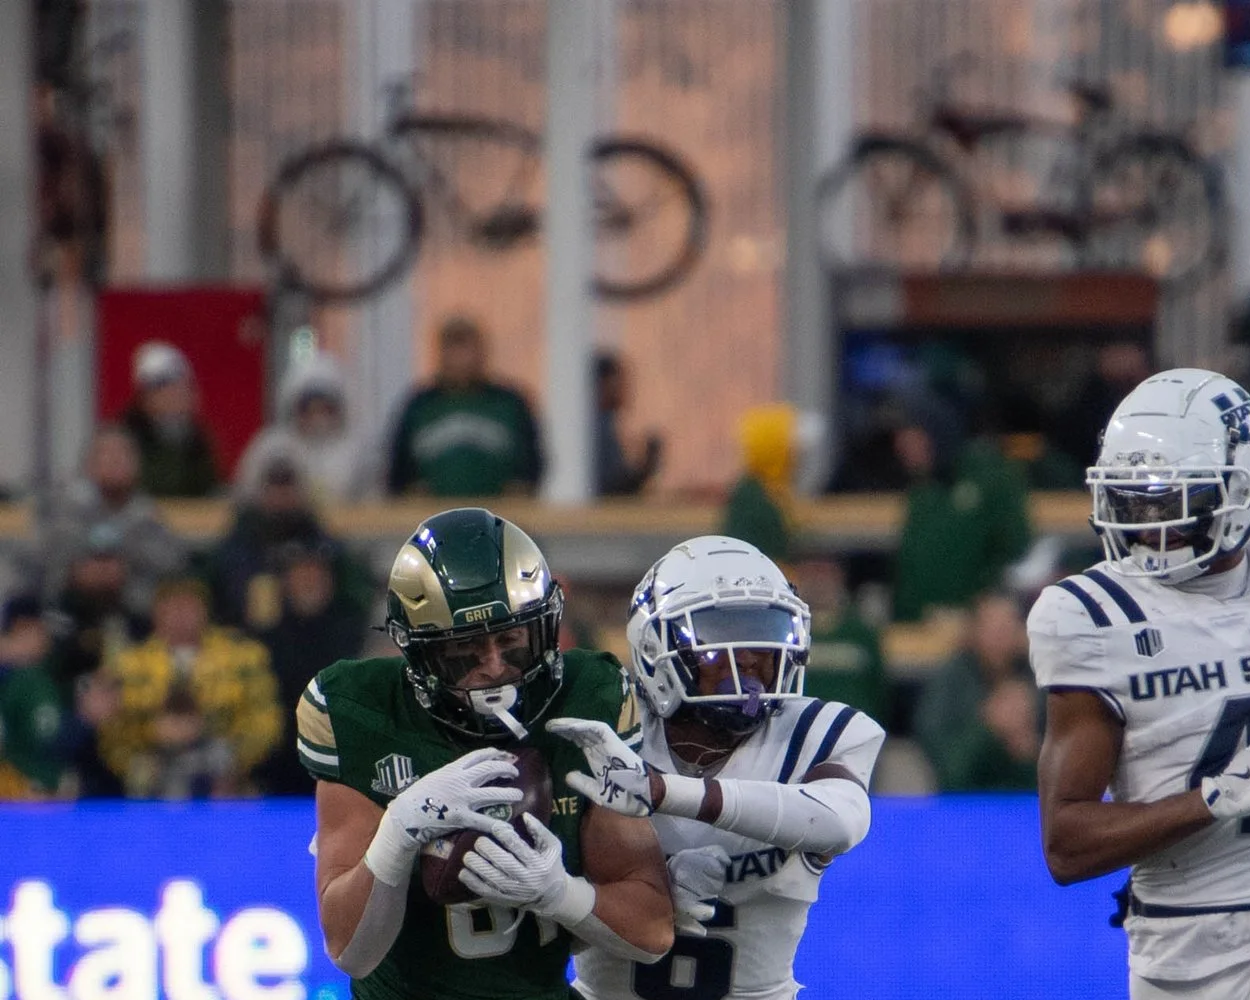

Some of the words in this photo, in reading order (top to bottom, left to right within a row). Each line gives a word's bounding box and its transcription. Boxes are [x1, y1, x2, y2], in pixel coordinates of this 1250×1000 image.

[464, 606, 493, 623] GRIT
[1129, 660, 1228, 702] UTAH
[551, 796, 578, 816] ATE
